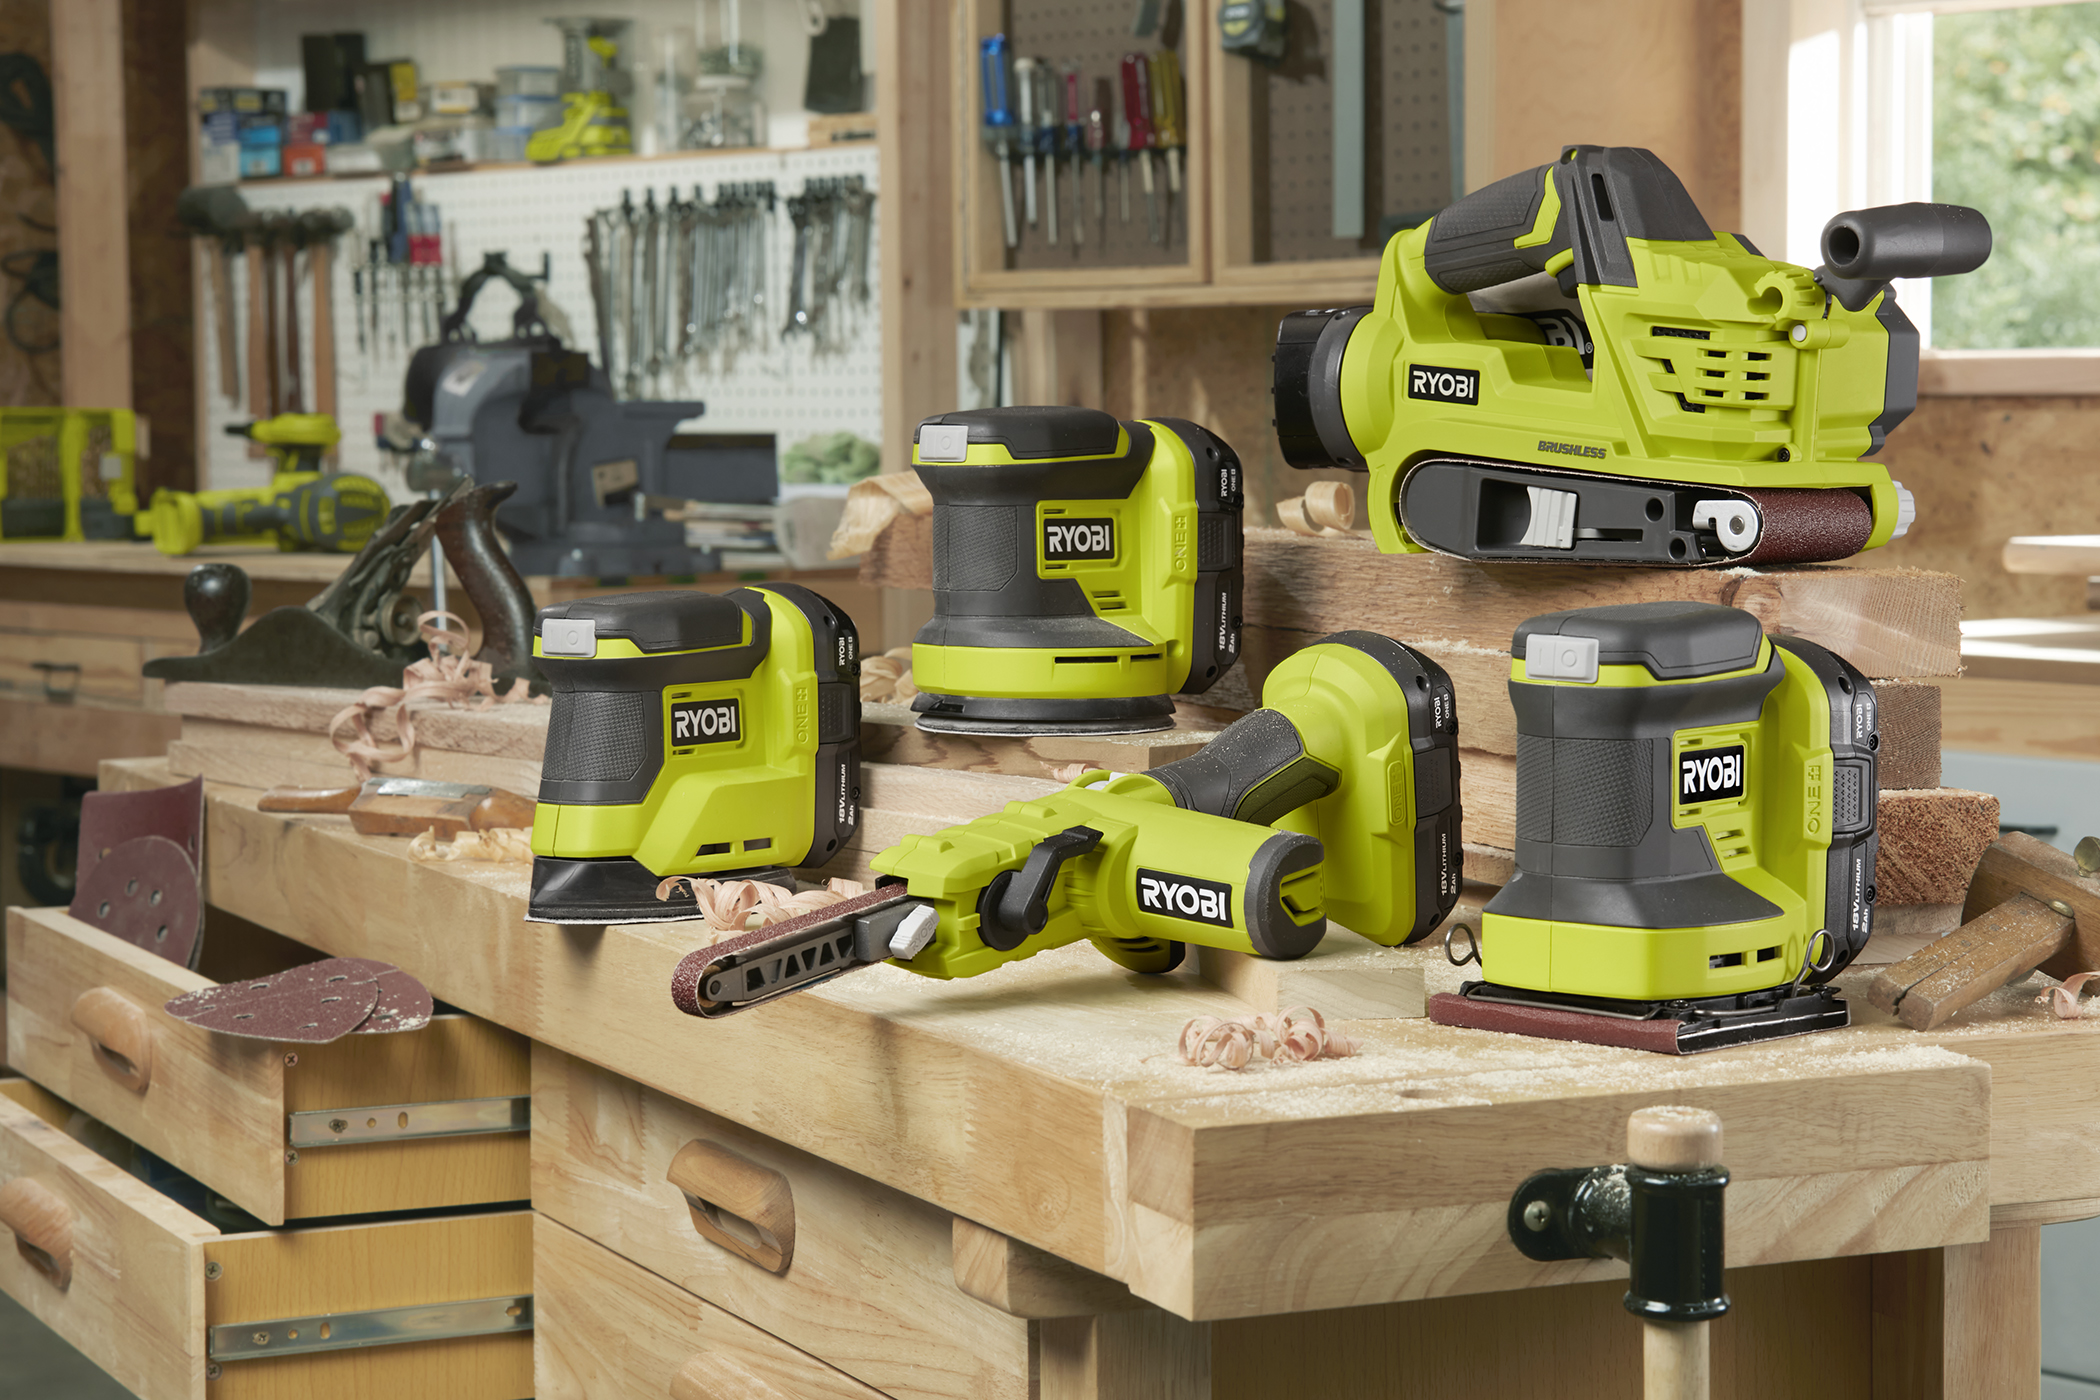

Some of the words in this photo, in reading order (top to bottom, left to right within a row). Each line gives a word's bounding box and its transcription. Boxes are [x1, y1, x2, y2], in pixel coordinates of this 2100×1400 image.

[1413, 370, 1475, 399] RYOBI
[1537, 440, 1607, 460] BRUSHLESS
[1220, 468, 1228, 497] RYOBI
[1046, 524, 1111, 553] RYOBI
[838, 636, 846, 667] RYOBI
[673, 705, 737, 738] RYOBI
[1433, 696, 1442, 729] RYOBI
[1682, 753, 1742, 795] RYOBI
[1140, 877, 1227, 922] RYOBI
[909, 917, 936, 951] RYOBI
